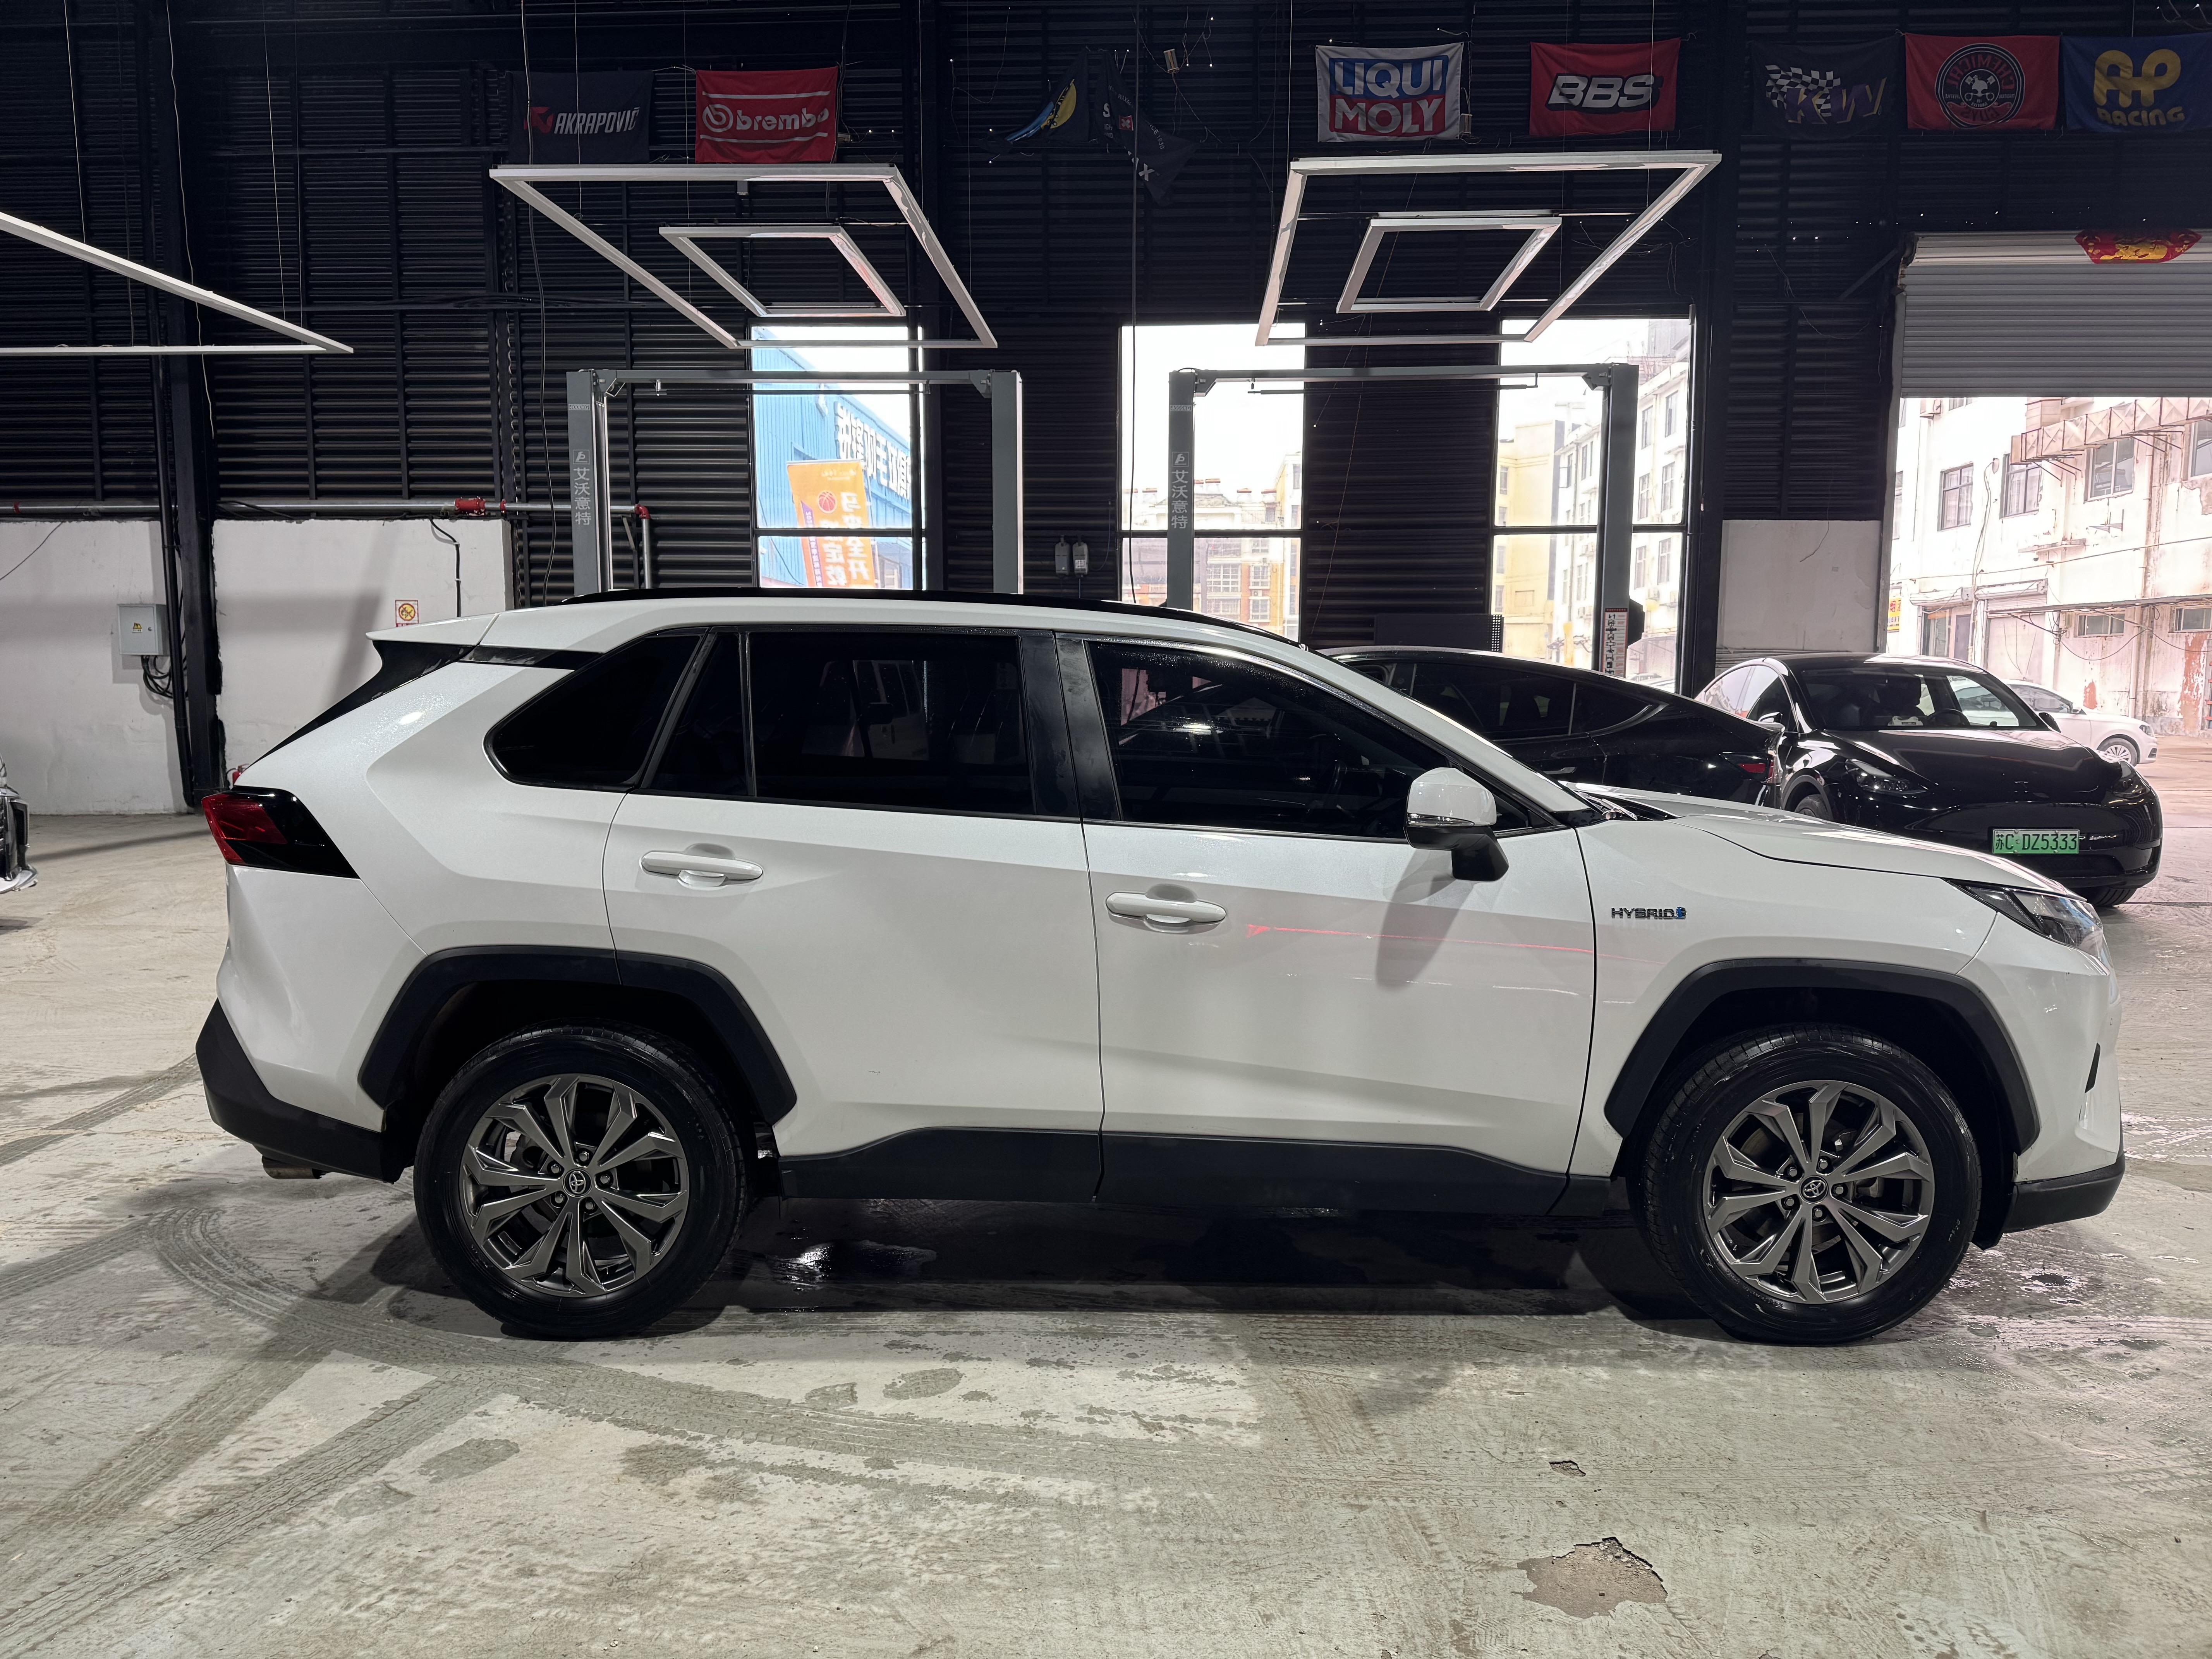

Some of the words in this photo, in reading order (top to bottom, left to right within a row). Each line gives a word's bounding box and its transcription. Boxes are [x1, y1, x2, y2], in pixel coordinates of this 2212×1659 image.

[1335, 59, 1444, 99] LIQUI
[1548, 74, 1654, 108] BBS
[554, 106, 640, 134] AKRAPOVIČ
[737, 107, 829, 131] brembo
[1335, 97, 1443, 134] MOLY
[574, 467, 591, 525] 艾沃意特
[1171, 470, 1188, 529] 艾沃意特
[1611, 907, 1674, 919] HYBRID
